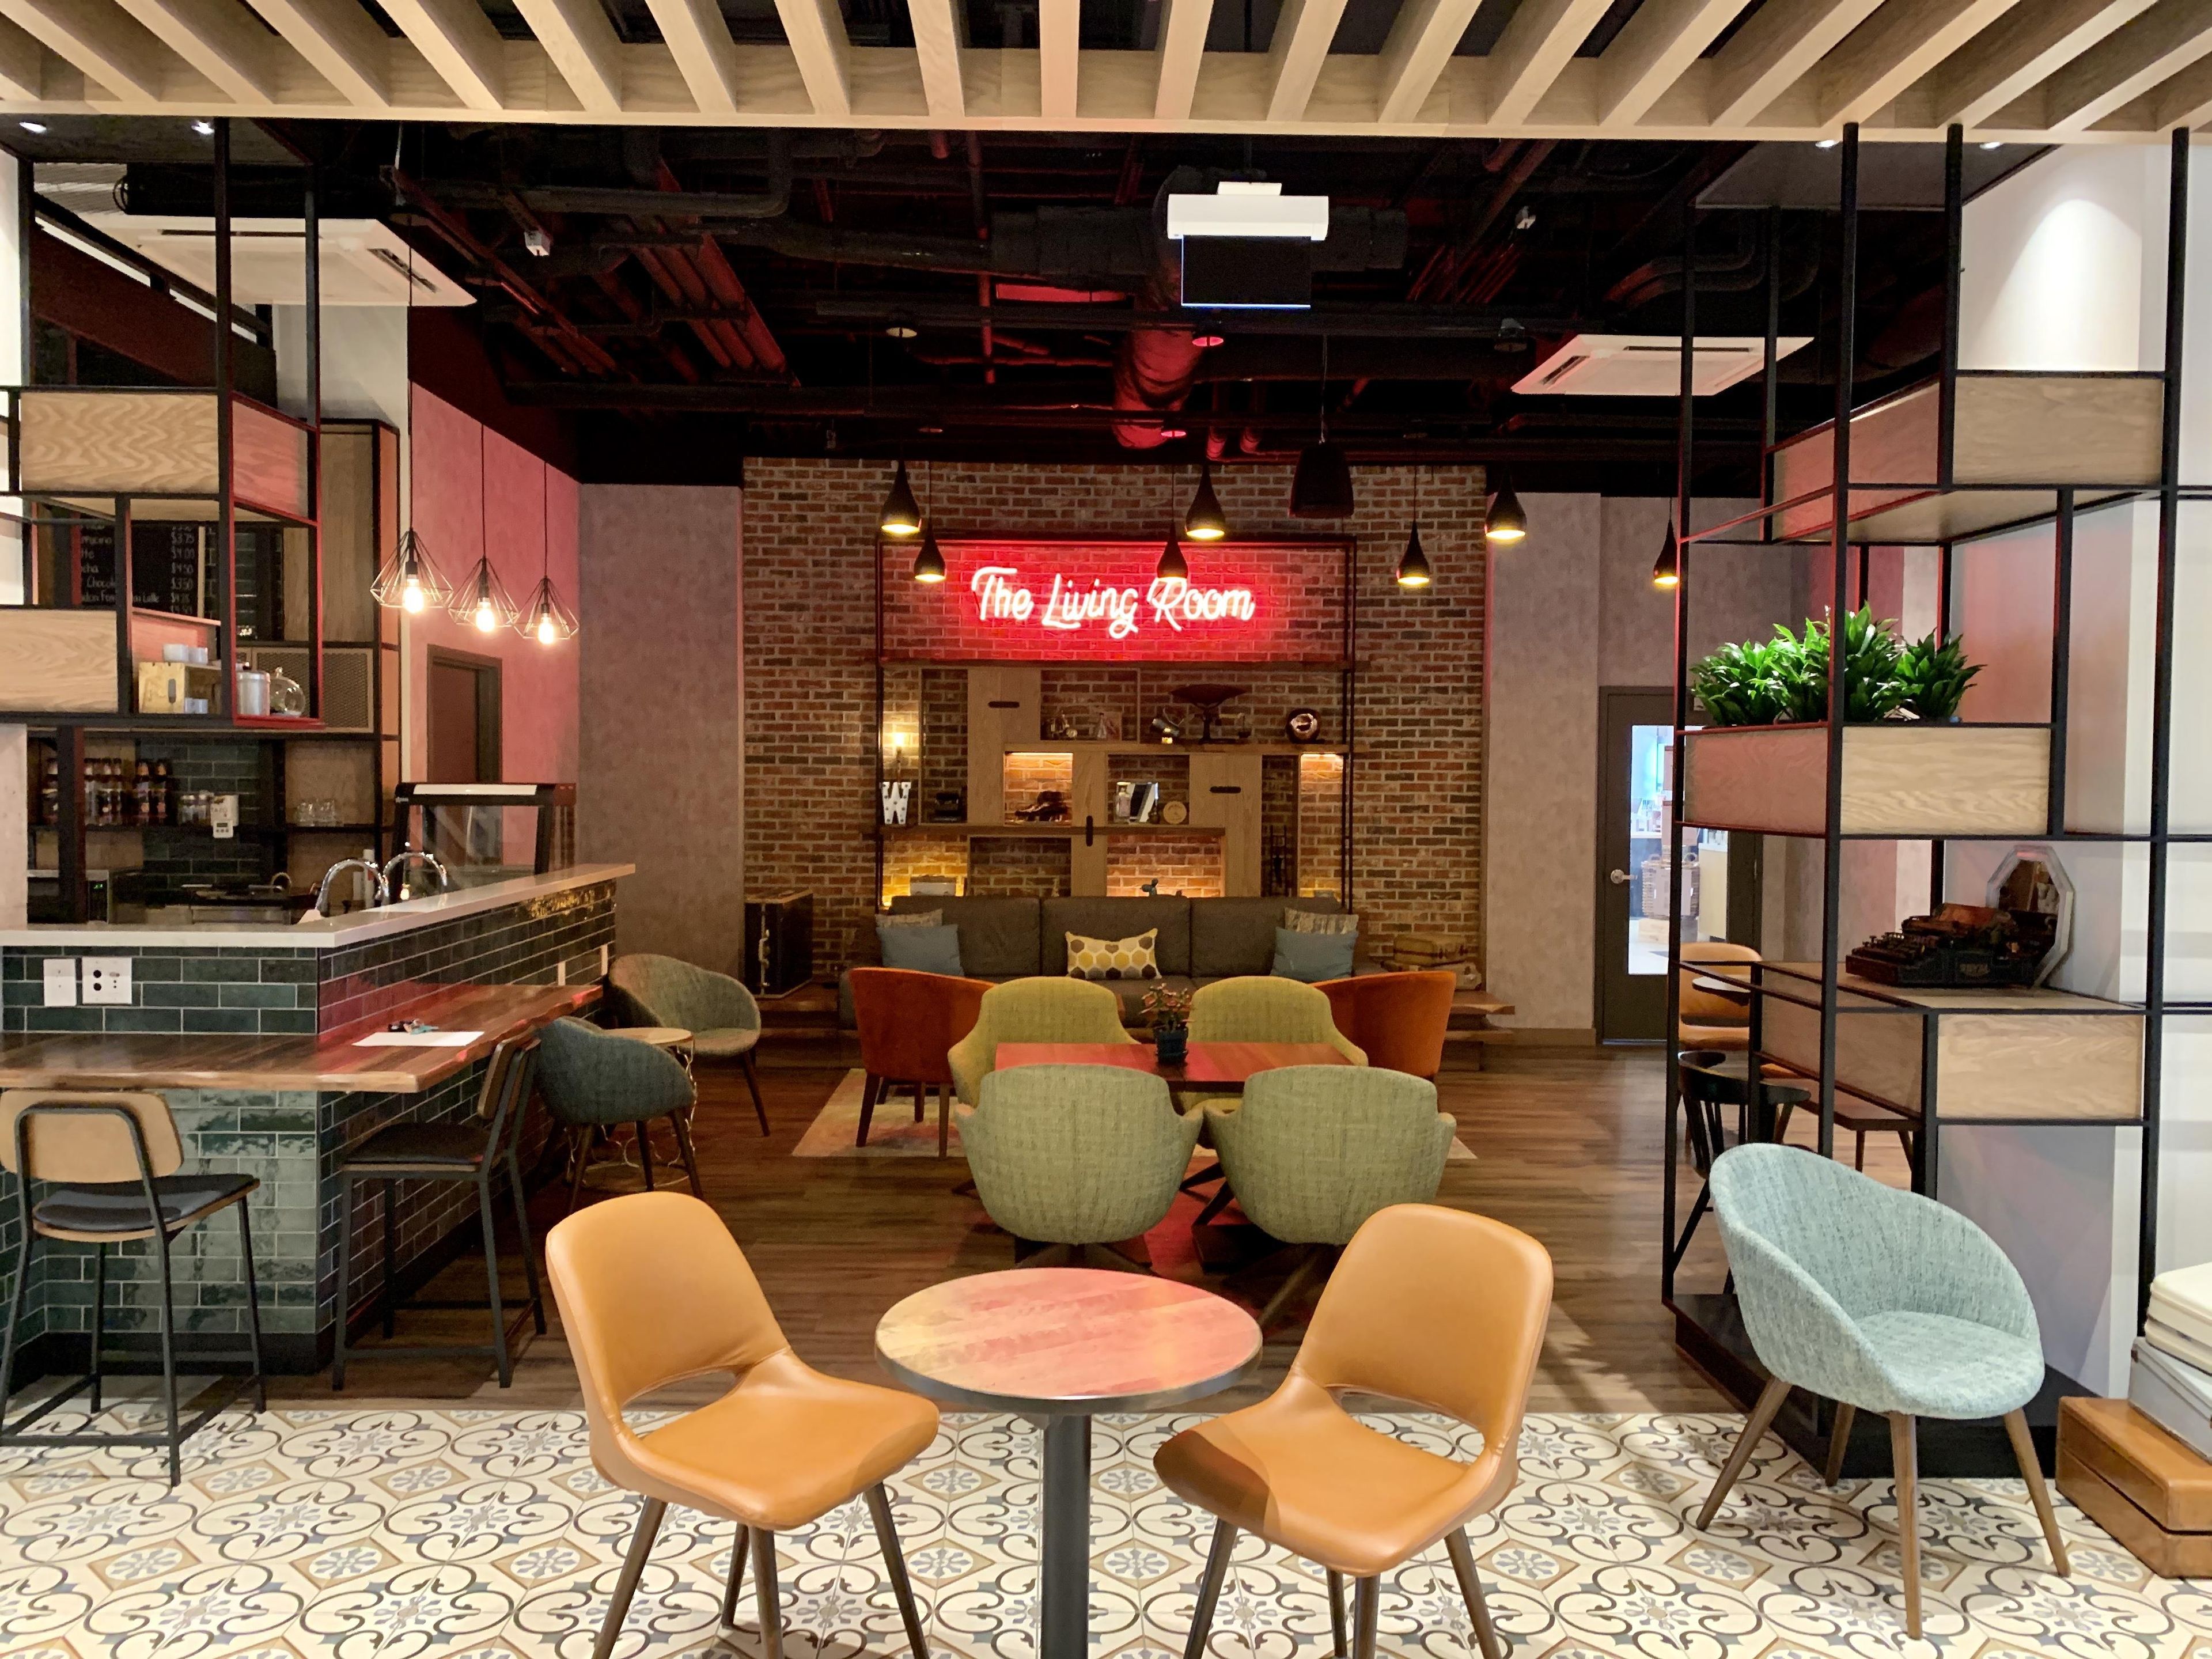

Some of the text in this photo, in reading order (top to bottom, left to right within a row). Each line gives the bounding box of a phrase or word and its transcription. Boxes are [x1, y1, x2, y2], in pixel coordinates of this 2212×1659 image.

[971, 567, 1256, 639] The Living Room
